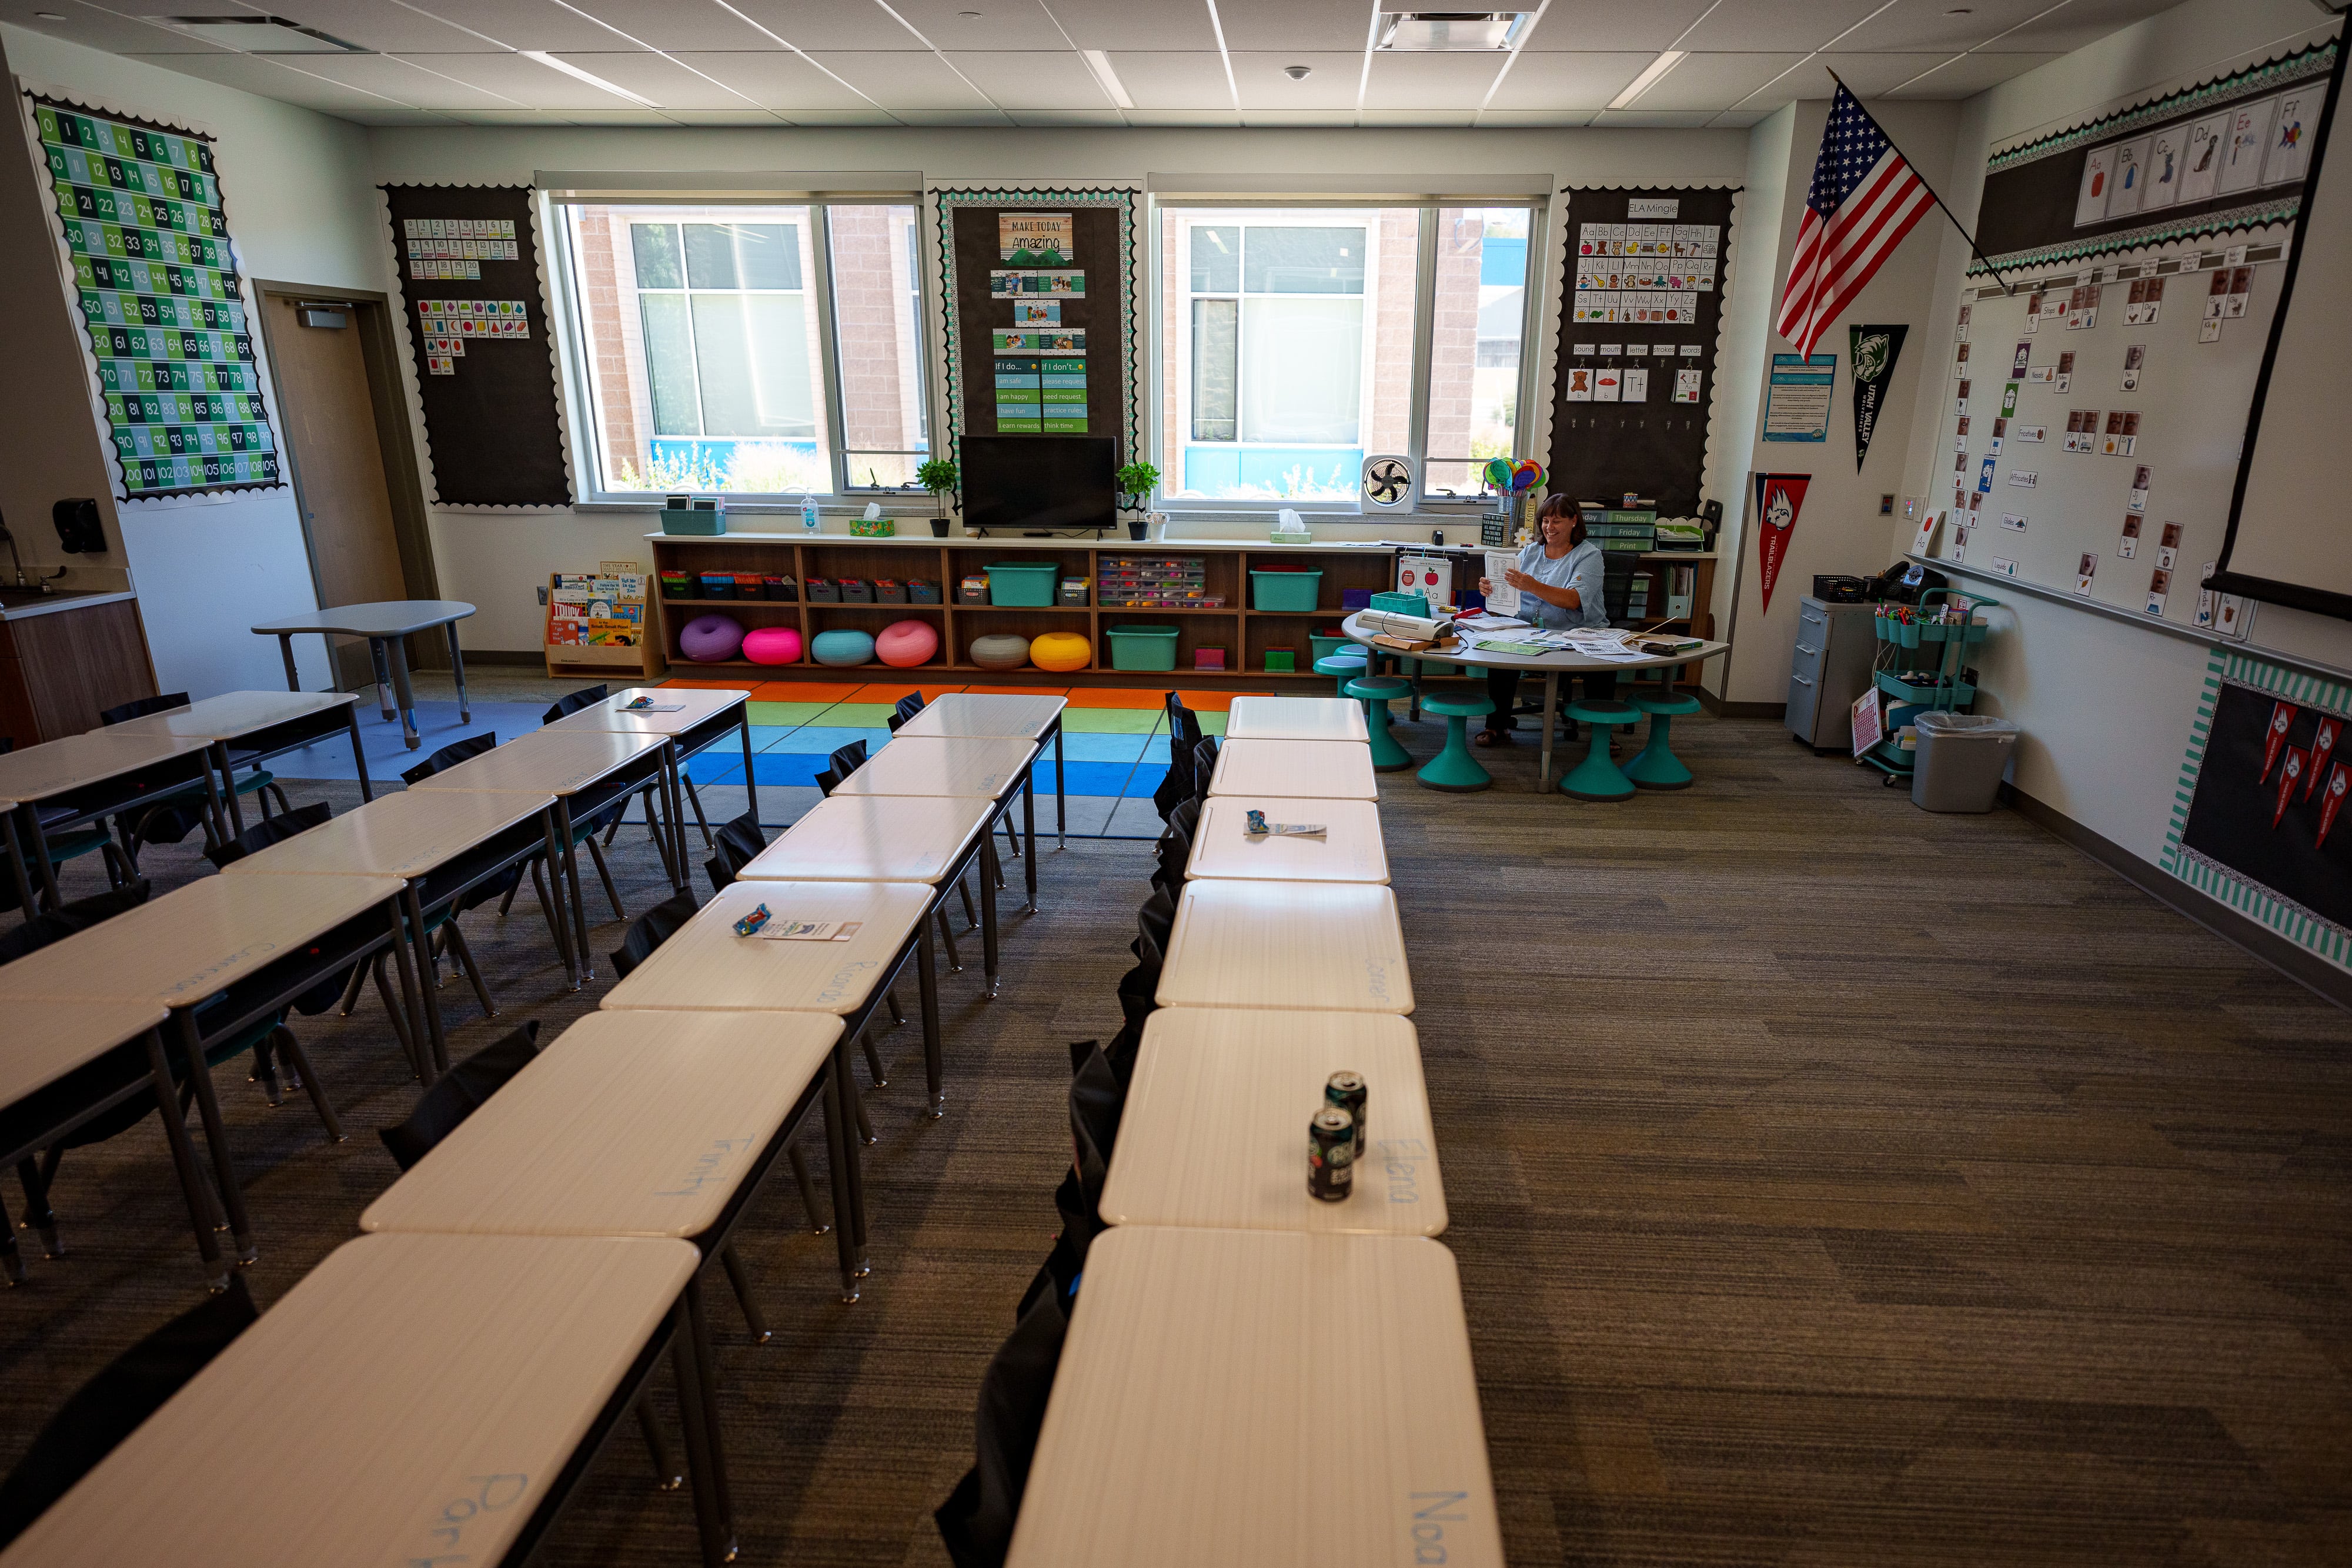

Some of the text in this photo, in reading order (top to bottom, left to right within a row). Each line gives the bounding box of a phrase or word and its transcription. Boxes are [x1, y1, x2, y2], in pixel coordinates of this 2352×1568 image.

[2283, 100, 2300, 118] Ff
[2236, 113, 2251, 131] Ee
[44, 118, 52, 132] 0
[65, 122, 71, 136] 1
[83, 126, 93, 141] 2
[100, 131, 109, 145] 3
[119, 135, 128, 149] 4
[136, 138, 145, 152] 5
[156, 143, 164, 156] 6
[191, 150, 196, 162] 8
[201, 153, 208, 165] 9
[2194, 125, 2209, 143] Dd
[2157, 140, 2169, 155] Cc
[2122, 148, 2133, 163] Bb
[2089, 158, 2102, 172] Aa
[1629, 204, 1678, 215] ELA Mingle
[1012, 222, 1061, 231] MAKE TODAY
[1582, 226, 1715, 239] Aa Bb Cc Dd Ee Ff Gg Hh Ii
[67, 229, 228, 261] 30 31 32 33 34 35 36 37 38 39
[1013, 235, 1060, 253] Amazing
[1582, 259, 1590, 272] Jj
[1596, 261, 1605, 269] Kk
[1624, 261, 1639, 270] Mm
[1641, 262, 1652, 270] Nn
[1655, 261, 1668, 270] Oo
[1673, 260, 1682, 272] Pp
[1686, 260, 1699, 273] Qq
[1703, 262, 1713, 271] Rr
[85, 300, 242, 323] 50 51 52 53 54 55 56 57 58 59
[2043, 306, 2056, 315] Stops
[101, 370, 255, 383] 70 71 72 73 74 75 76 77 78 79
[1628, 377, 1644, 392] Tt
[1862, 385, 1876, 443] UTAH VALLEY
[2019, 429, 2037, 437] Fricatives
[2010, 474, 2028, 483] Affricates
[1526, 503, 1534, 522] KOYLE
[2004, 517, 2014, 526] Glides
[1916, 536, 1925, 547] Aa
[1765, 536, 1776, 589] TRAILBLAZERS
[553, 603, 579, 616] TRUCK
